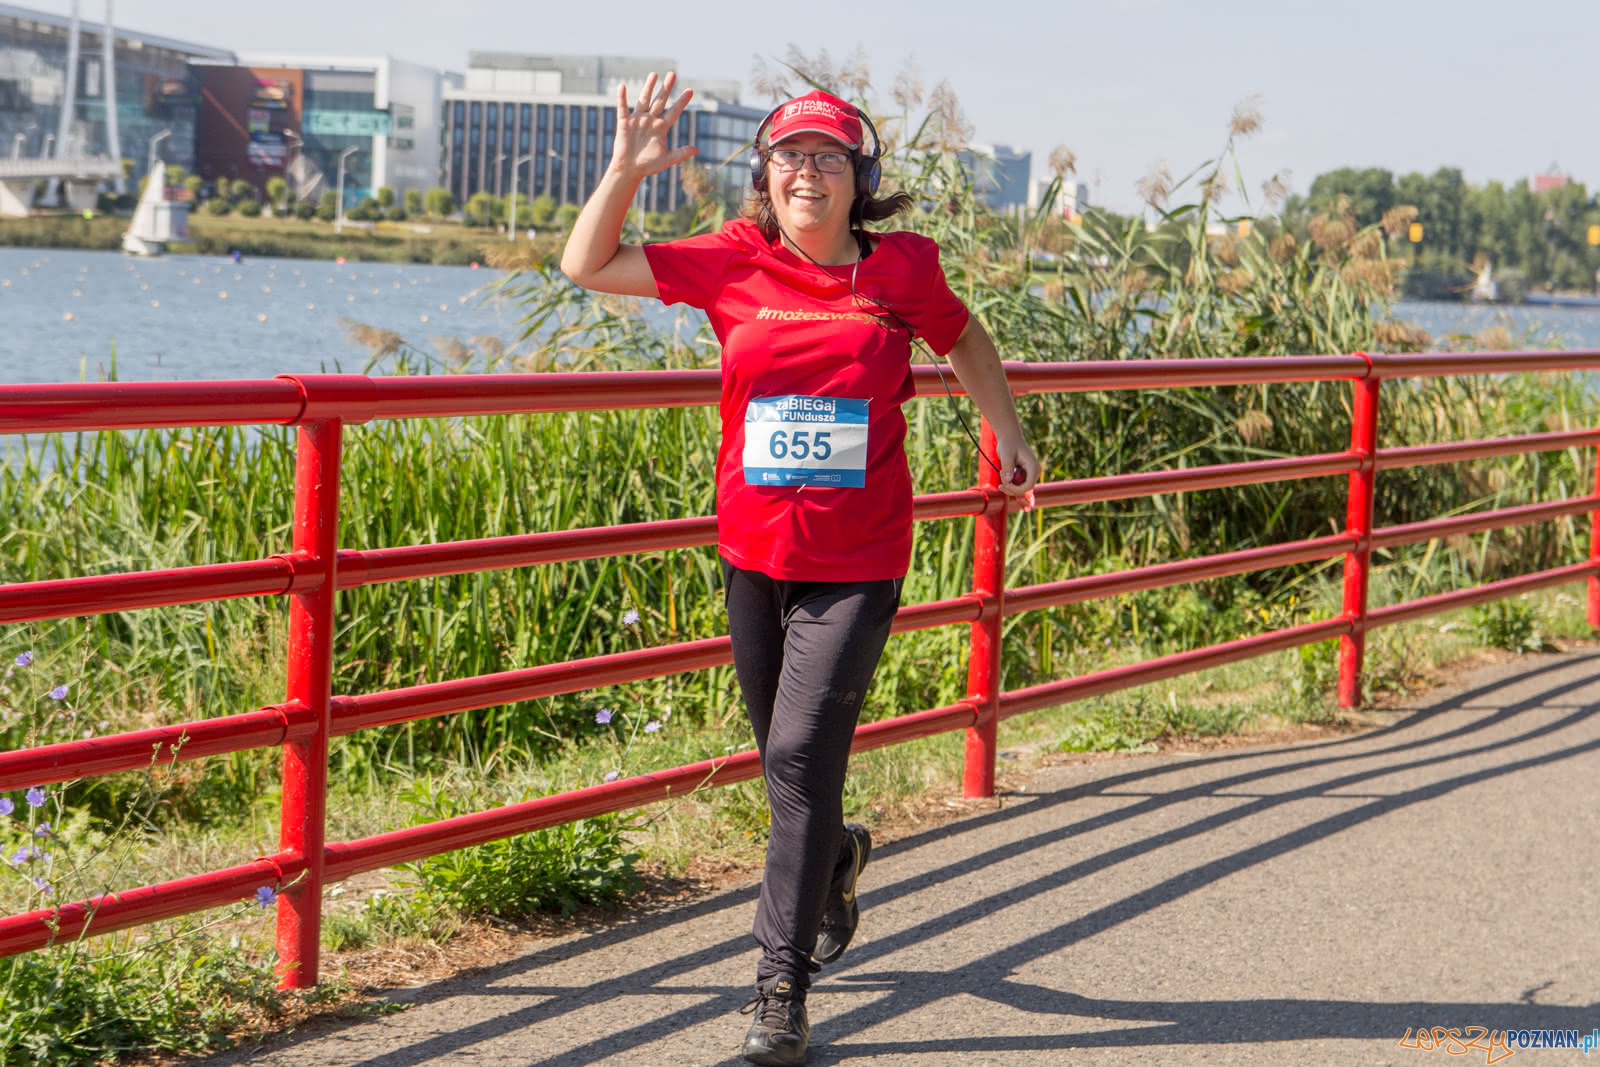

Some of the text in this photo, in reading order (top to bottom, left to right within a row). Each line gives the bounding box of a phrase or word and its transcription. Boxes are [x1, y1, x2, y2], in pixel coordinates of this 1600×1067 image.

[775, 398, 836, 414] zaBIEGaj
[782, 411, 836, 422] FUNdusze
[769, 430, 832, 461] 655
